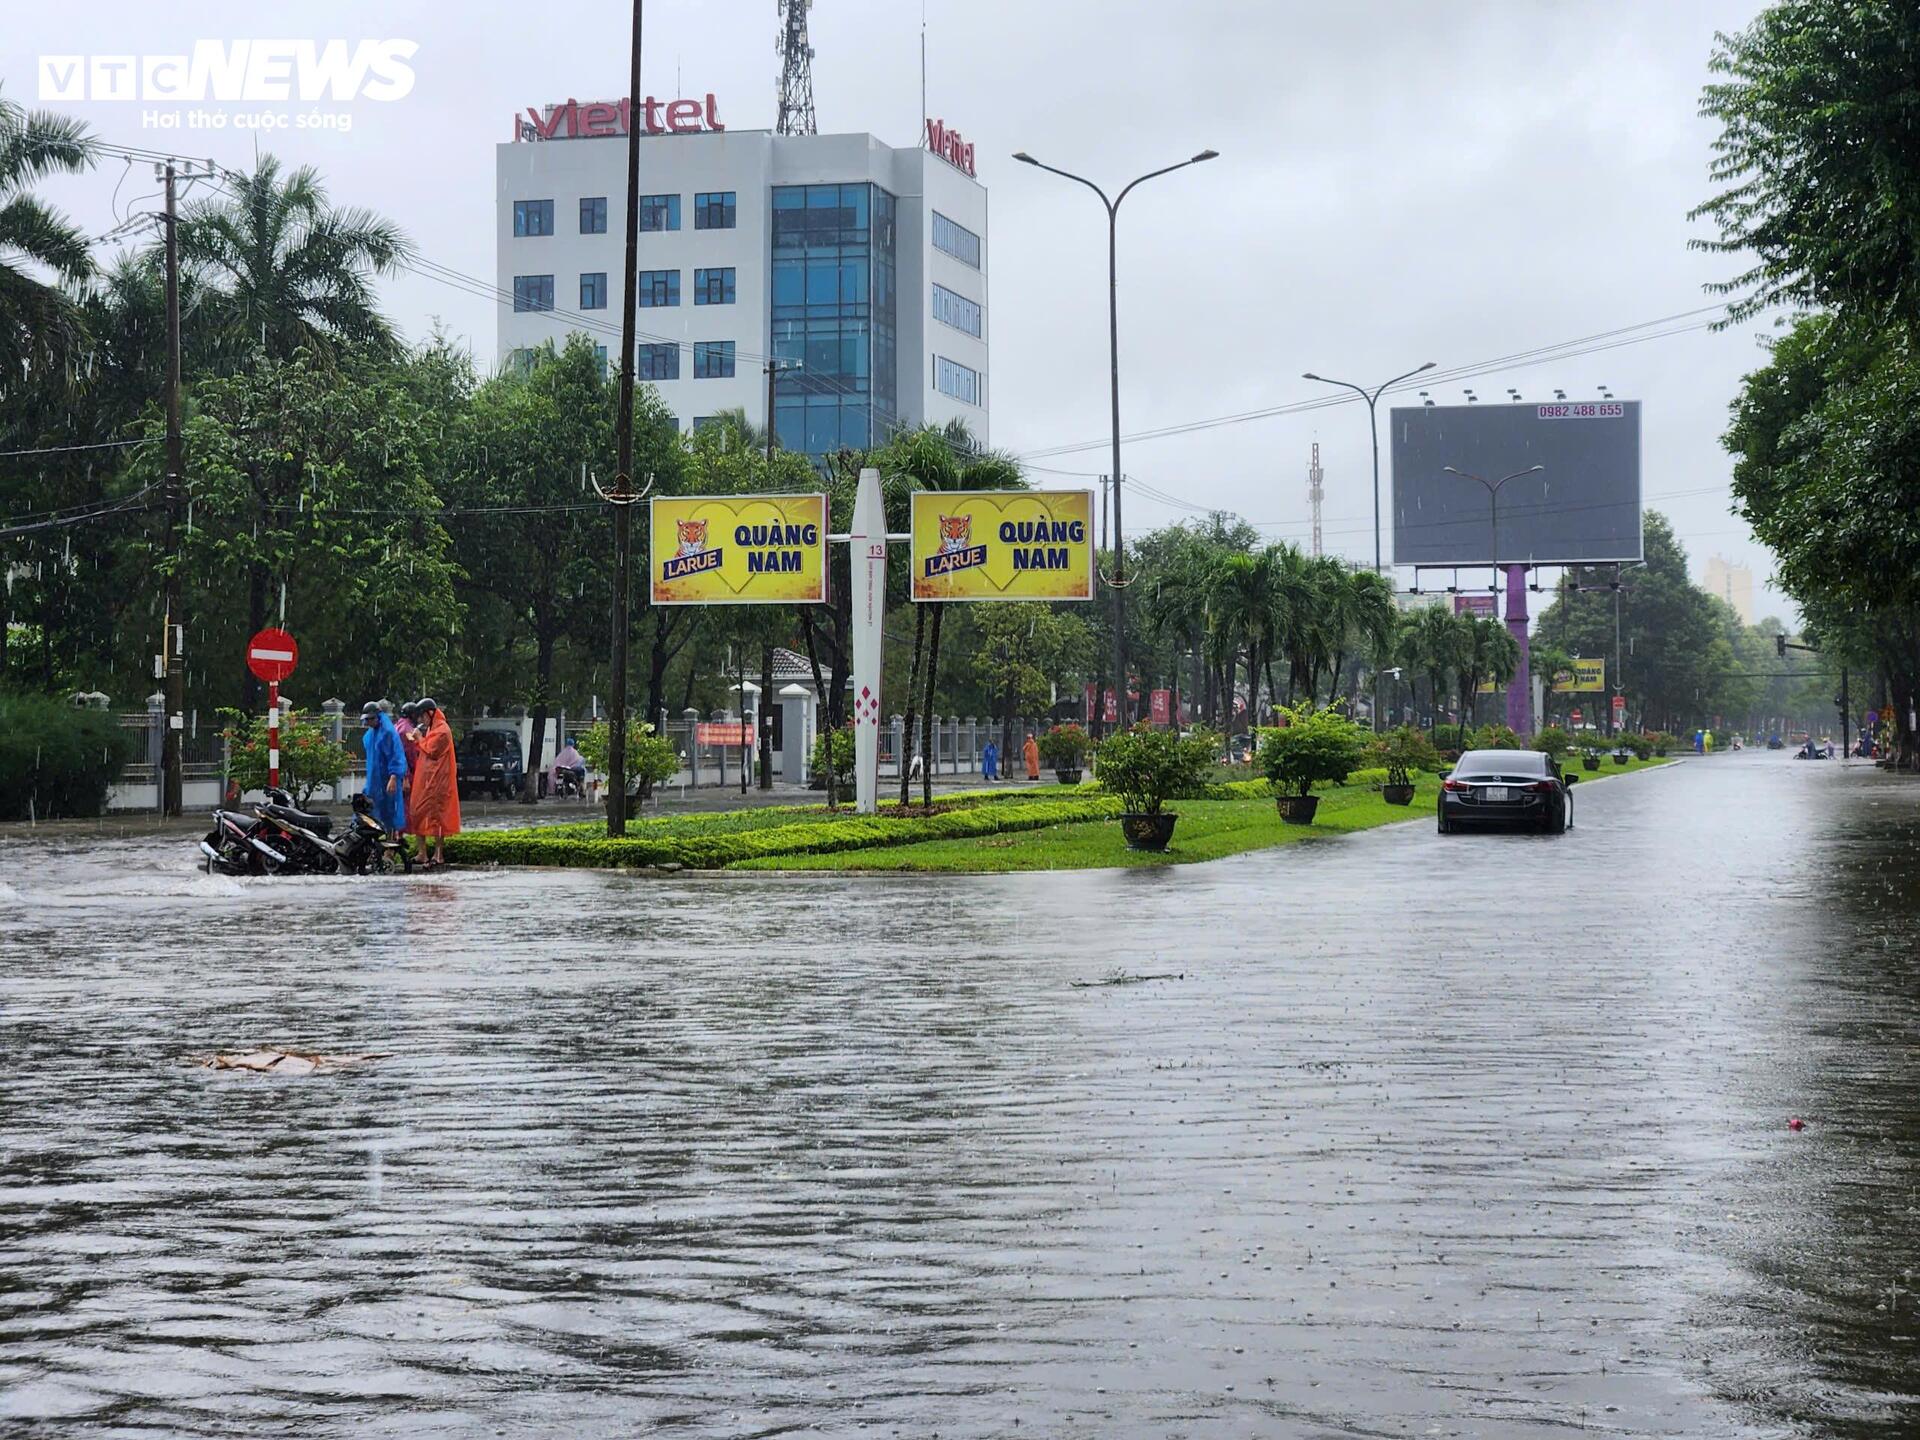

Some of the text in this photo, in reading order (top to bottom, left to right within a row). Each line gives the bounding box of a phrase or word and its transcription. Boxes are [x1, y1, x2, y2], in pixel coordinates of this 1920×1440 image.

[1540, 404, 1622, 417] 0982 488 655
[734, 518, 818, 547] QUẢNG
[999, 514, 1086, 544] QUẢNG
[869, 544, 883, 555] 13
[929, 547, 981, 574] LARUE
[1013, 547, 1070, 571] NAM
[668, 551, 717, 577] LARUE
[748, 551, 803, 574] NAM
